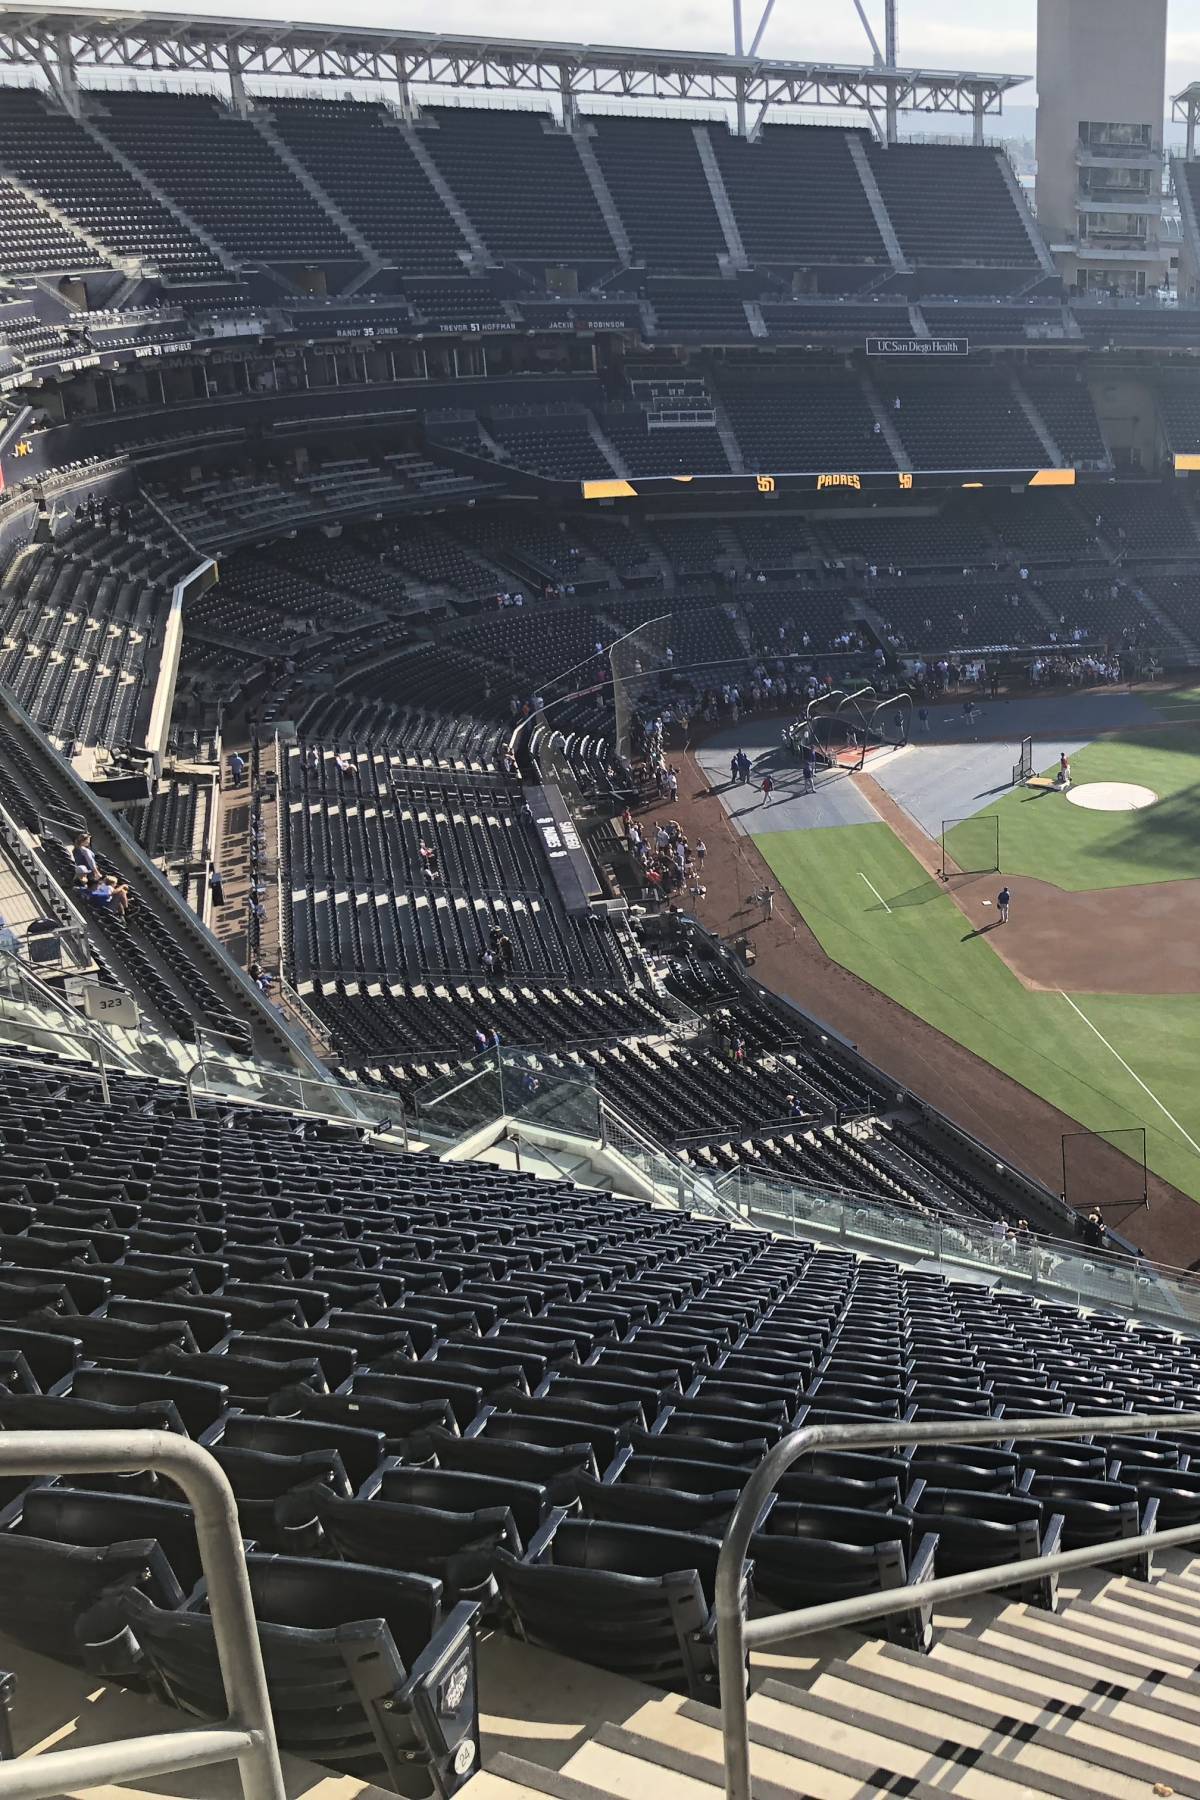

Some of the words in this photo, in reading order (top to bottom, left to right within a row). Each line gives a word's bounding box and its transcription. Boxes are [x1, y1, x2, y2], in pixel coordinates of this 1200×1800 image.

[440, 324, 468, 332] TREVOR
[470, 323, 480, 332] 51
[482, 322, 516, 331] HOFFMAN
[549, 321, 574, 329] JACKIE
[588, 320, 625, 329] ROBINSON
[337, 329, 361, 337] RANDY
[363, 328, 374, 337] 35
[375, 327, 399, 336] JONES
[135, 348, 152, 358] DAVE
[164, 342, 192, 354] WINFIELD
[878, 341, 891, 351] UC
[892, 341, 907, 351] San
[908, 341, 931, 353] Diego
[932, 341, 958, 352] Health
[816, 474, 861, 490] PADRES
[98, 998, 122, 1010] 323
[459, 1747, 470, 1768] 24
